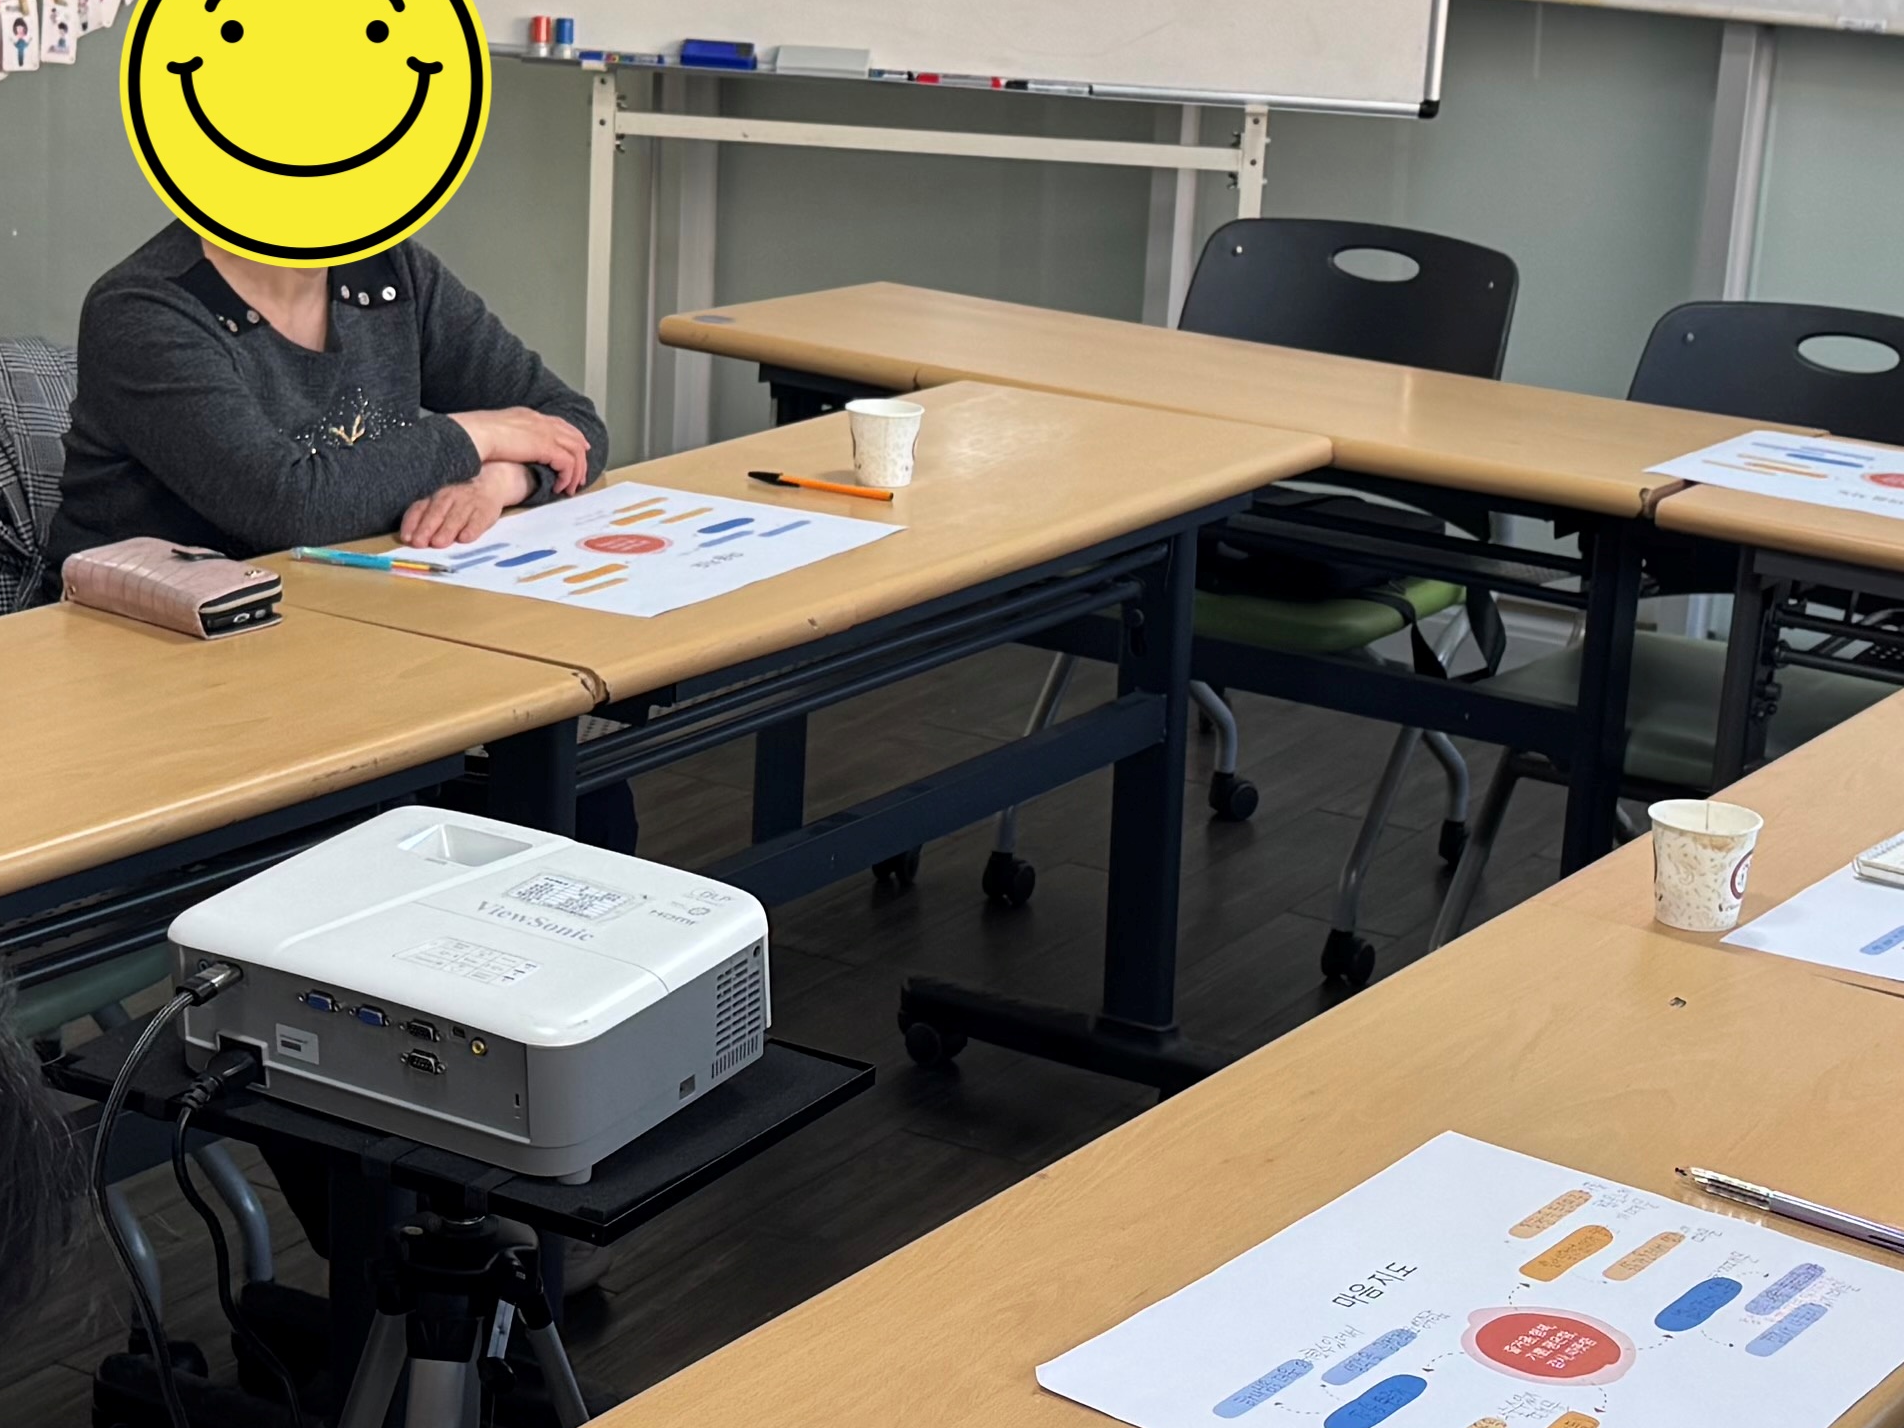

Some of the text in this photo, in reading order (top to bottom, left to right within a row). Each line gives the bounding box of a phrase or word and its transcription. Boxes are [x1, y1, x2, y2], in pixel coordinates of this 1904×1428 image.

[477, 900, 594, 942] ViewSonic
[1332, 1261, 1418, 1307] 마음 지도
